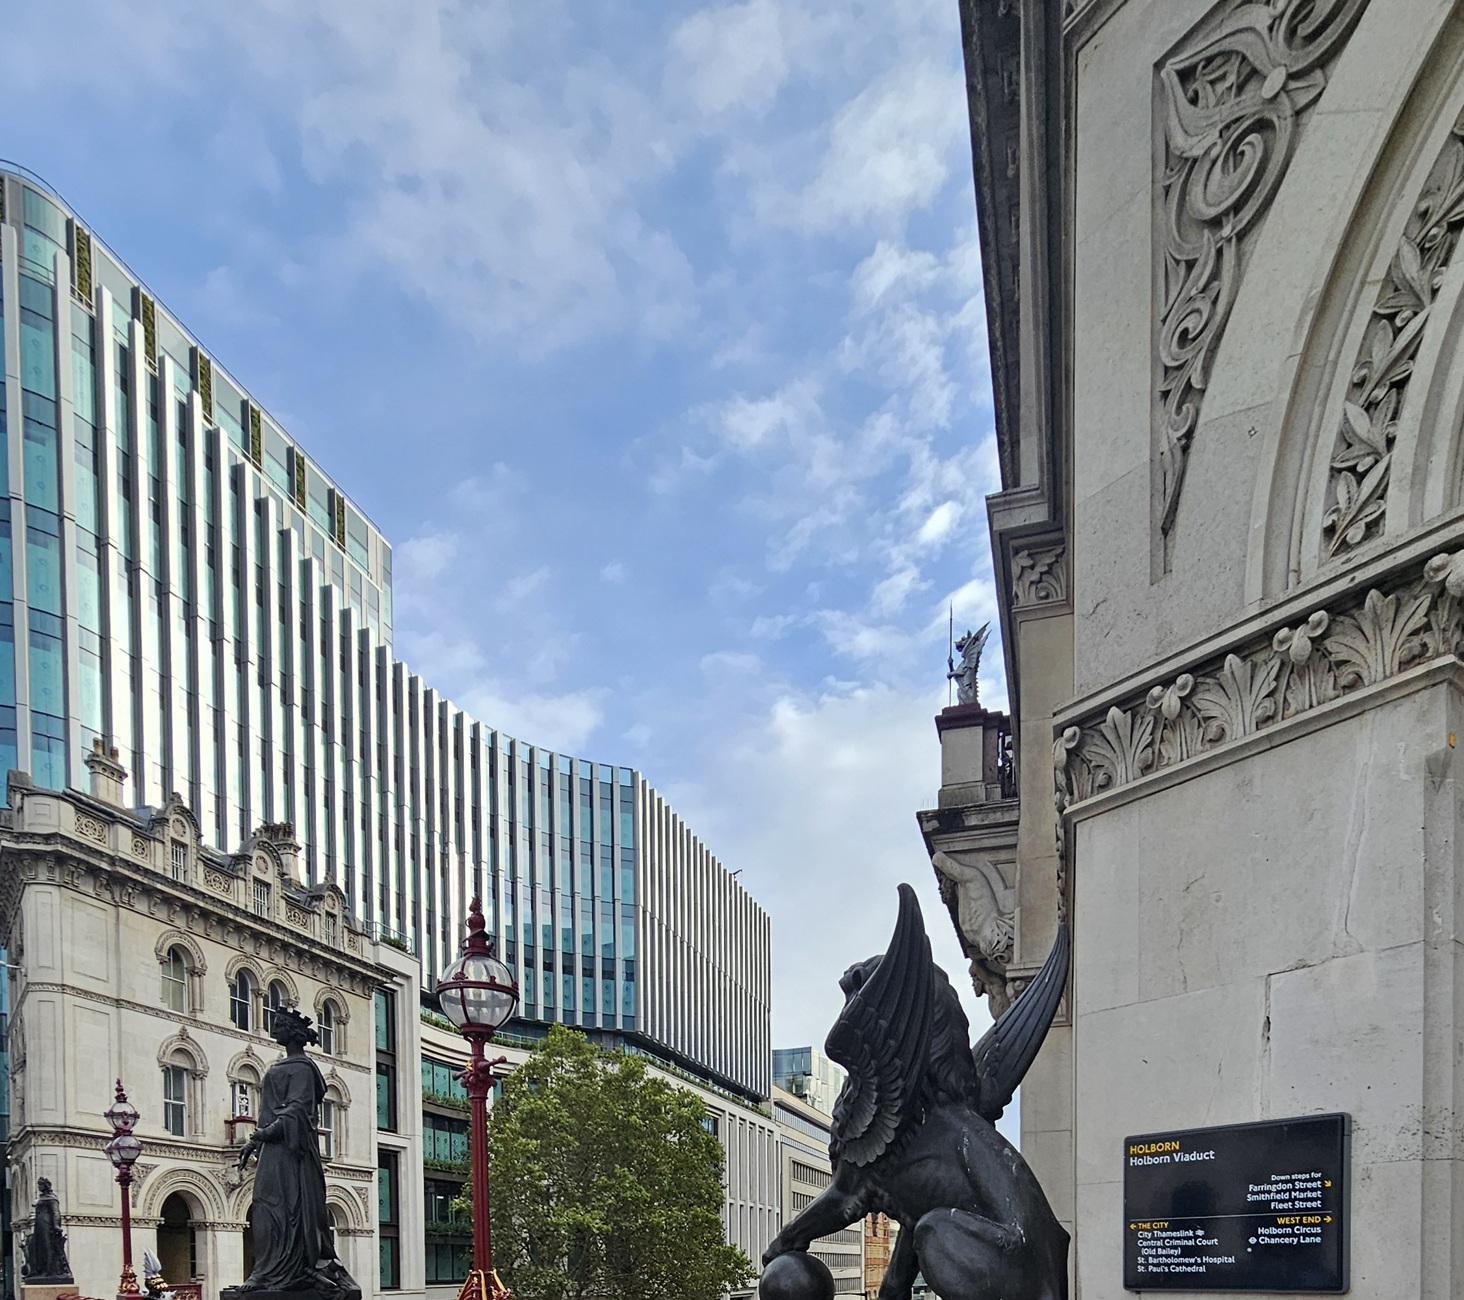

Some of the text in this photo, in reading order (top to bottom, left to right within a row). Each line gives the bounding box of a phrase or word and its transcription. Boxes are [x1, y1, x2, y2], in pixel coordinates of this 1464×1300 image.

[1130, 1141, 1180, 1154] HOLBORN
[1130, 1150, 1215, 1166] Holborn Viaduct
[1249, 1181, 1322, 1192] Farringdon Street
[1247, 1190, 1322, 1201] Smithfield Market
[1271, 1202, 1292, 1210] Fleet
[1138, 1231, 1152, 1240] City
[1258, 1236, 1298, 1244] Chancery
[1142, 1248, 1181, 1256] (Old Bailey)
[1202, 1256, 1235, 1264] Hospital
